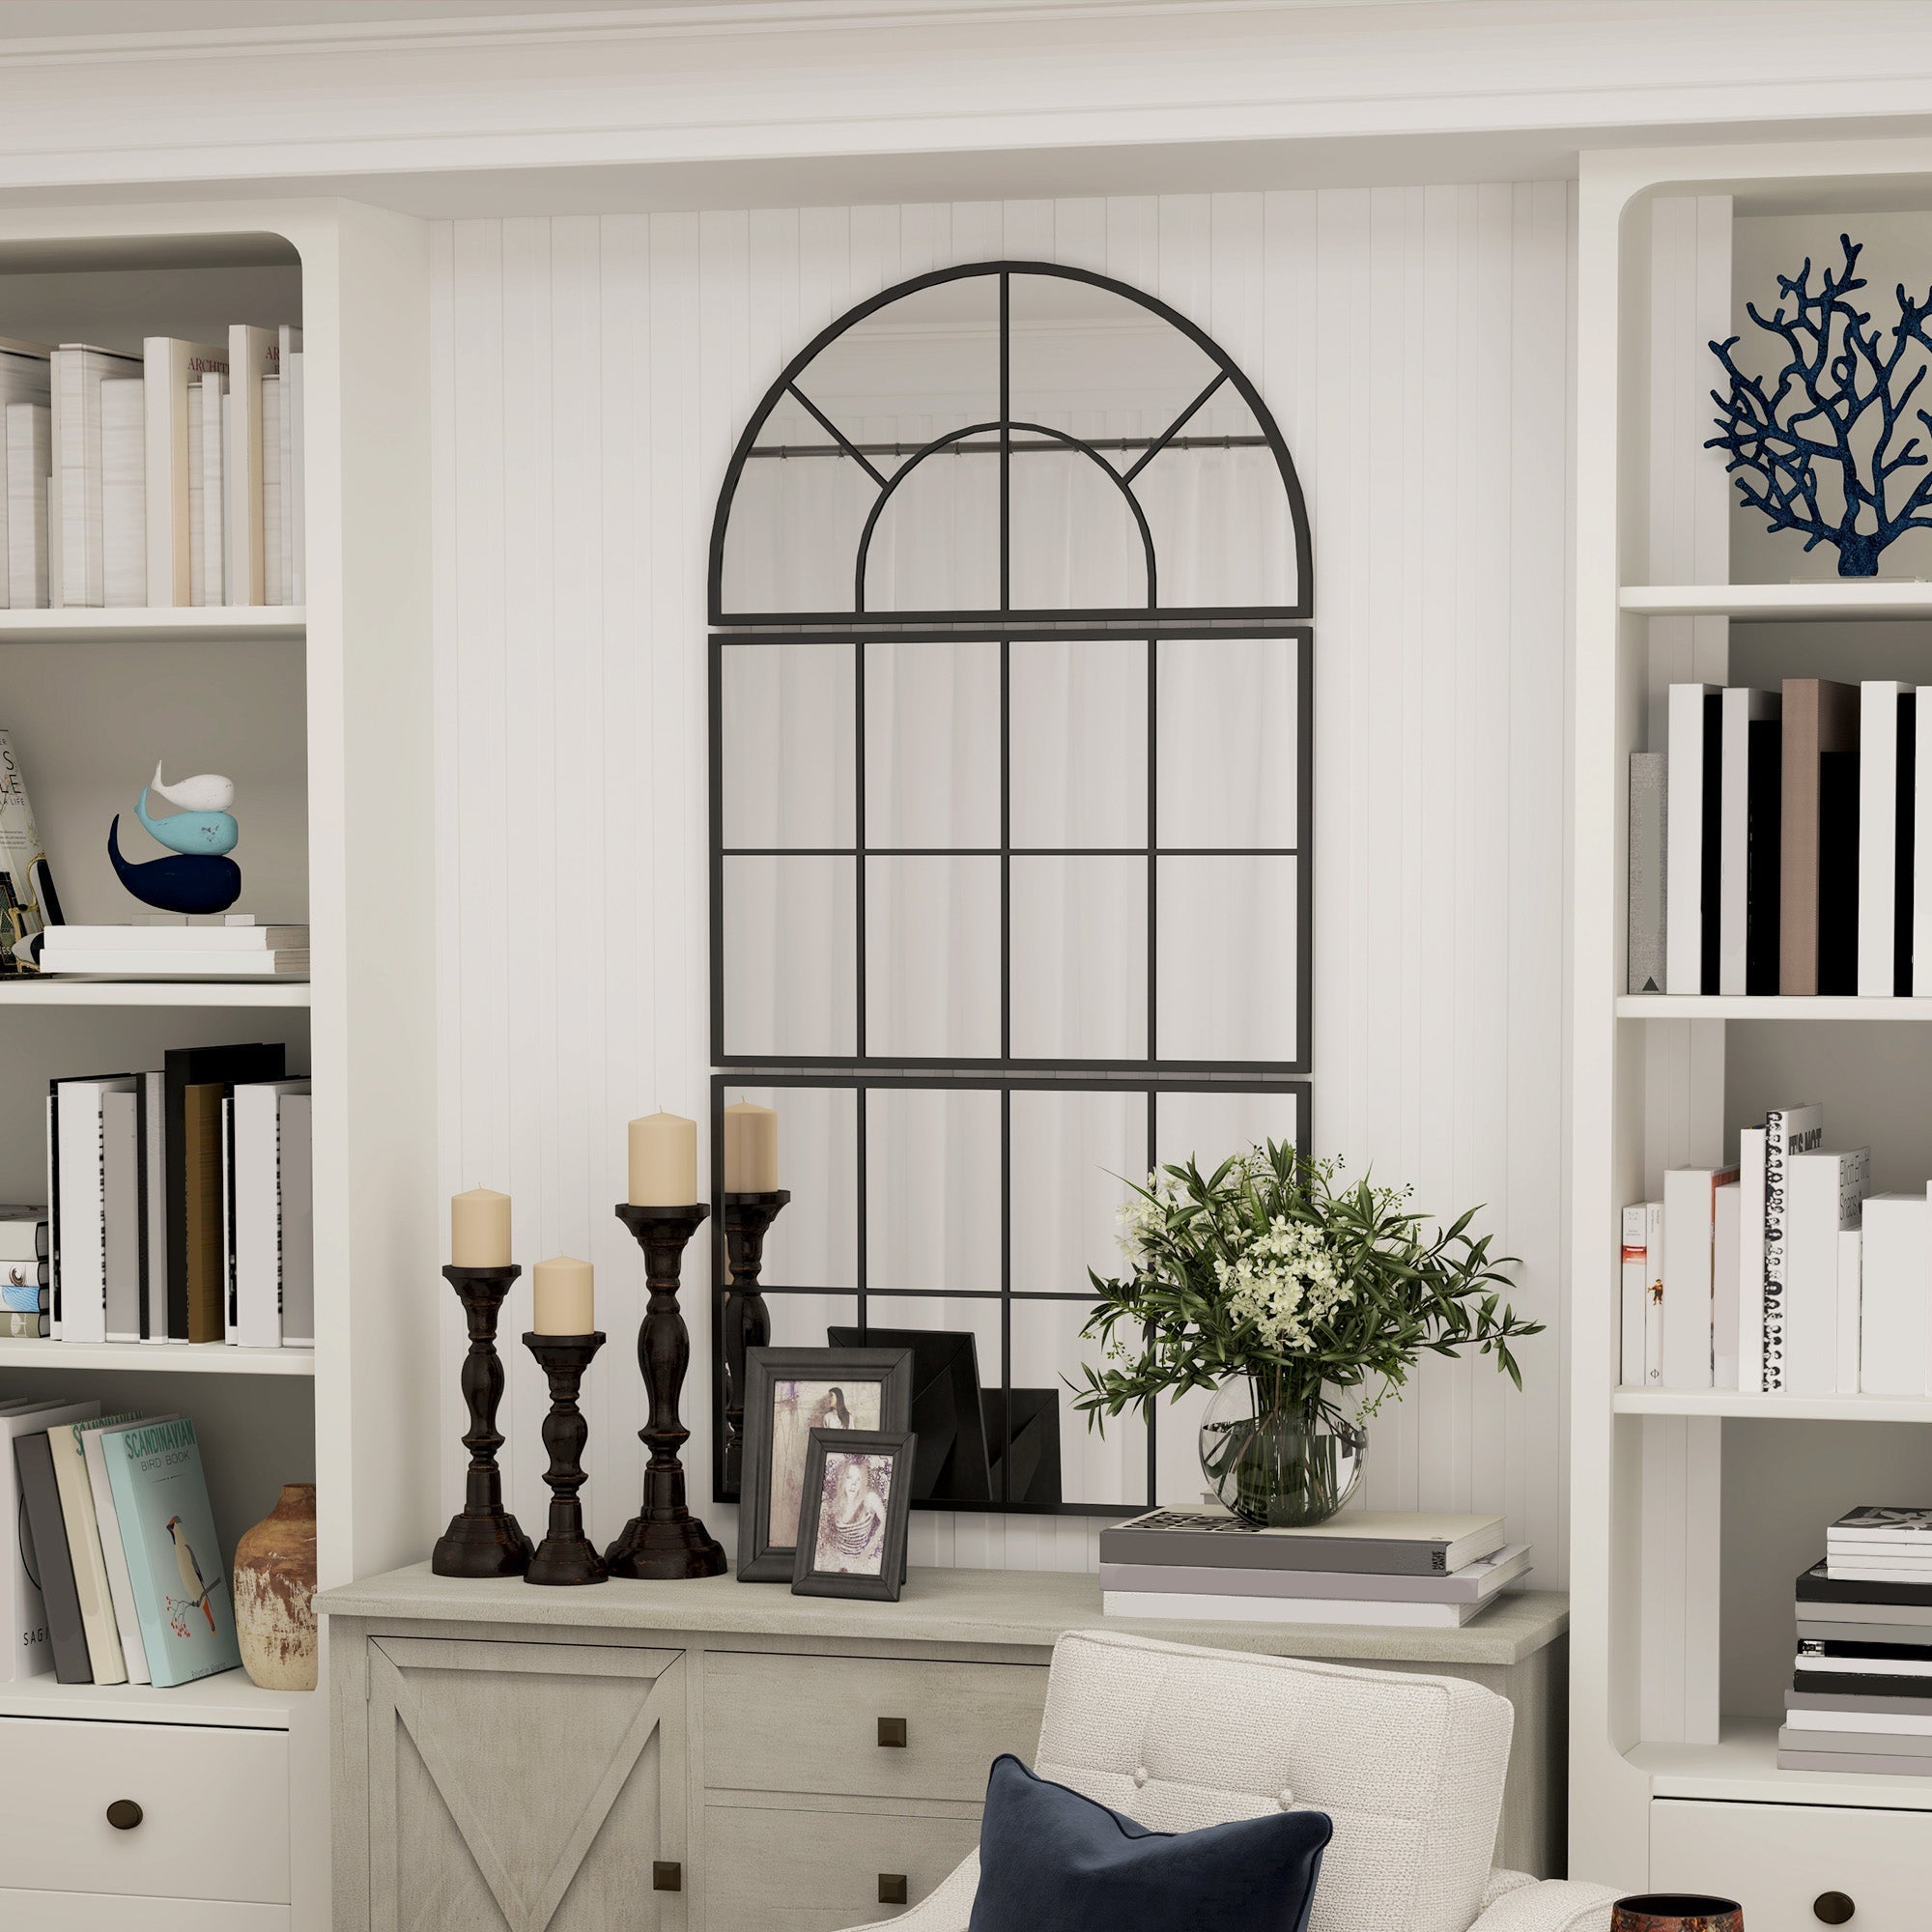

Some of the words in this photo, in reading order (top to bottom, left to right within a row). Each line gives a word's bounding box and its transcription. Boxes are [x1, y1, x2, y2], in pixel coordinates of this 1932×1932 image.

[188, 357, 229, 375] ARCHIT
[10, 797, 25, 806] LIFE
[1804, 1127, 1822, 1151] NOT
[125, 1420, 196, 1460] SCANDINAVIAN
[141, 1457, 162, 1472] BIRD
[166, 1451, 191, 1466] BOOK
